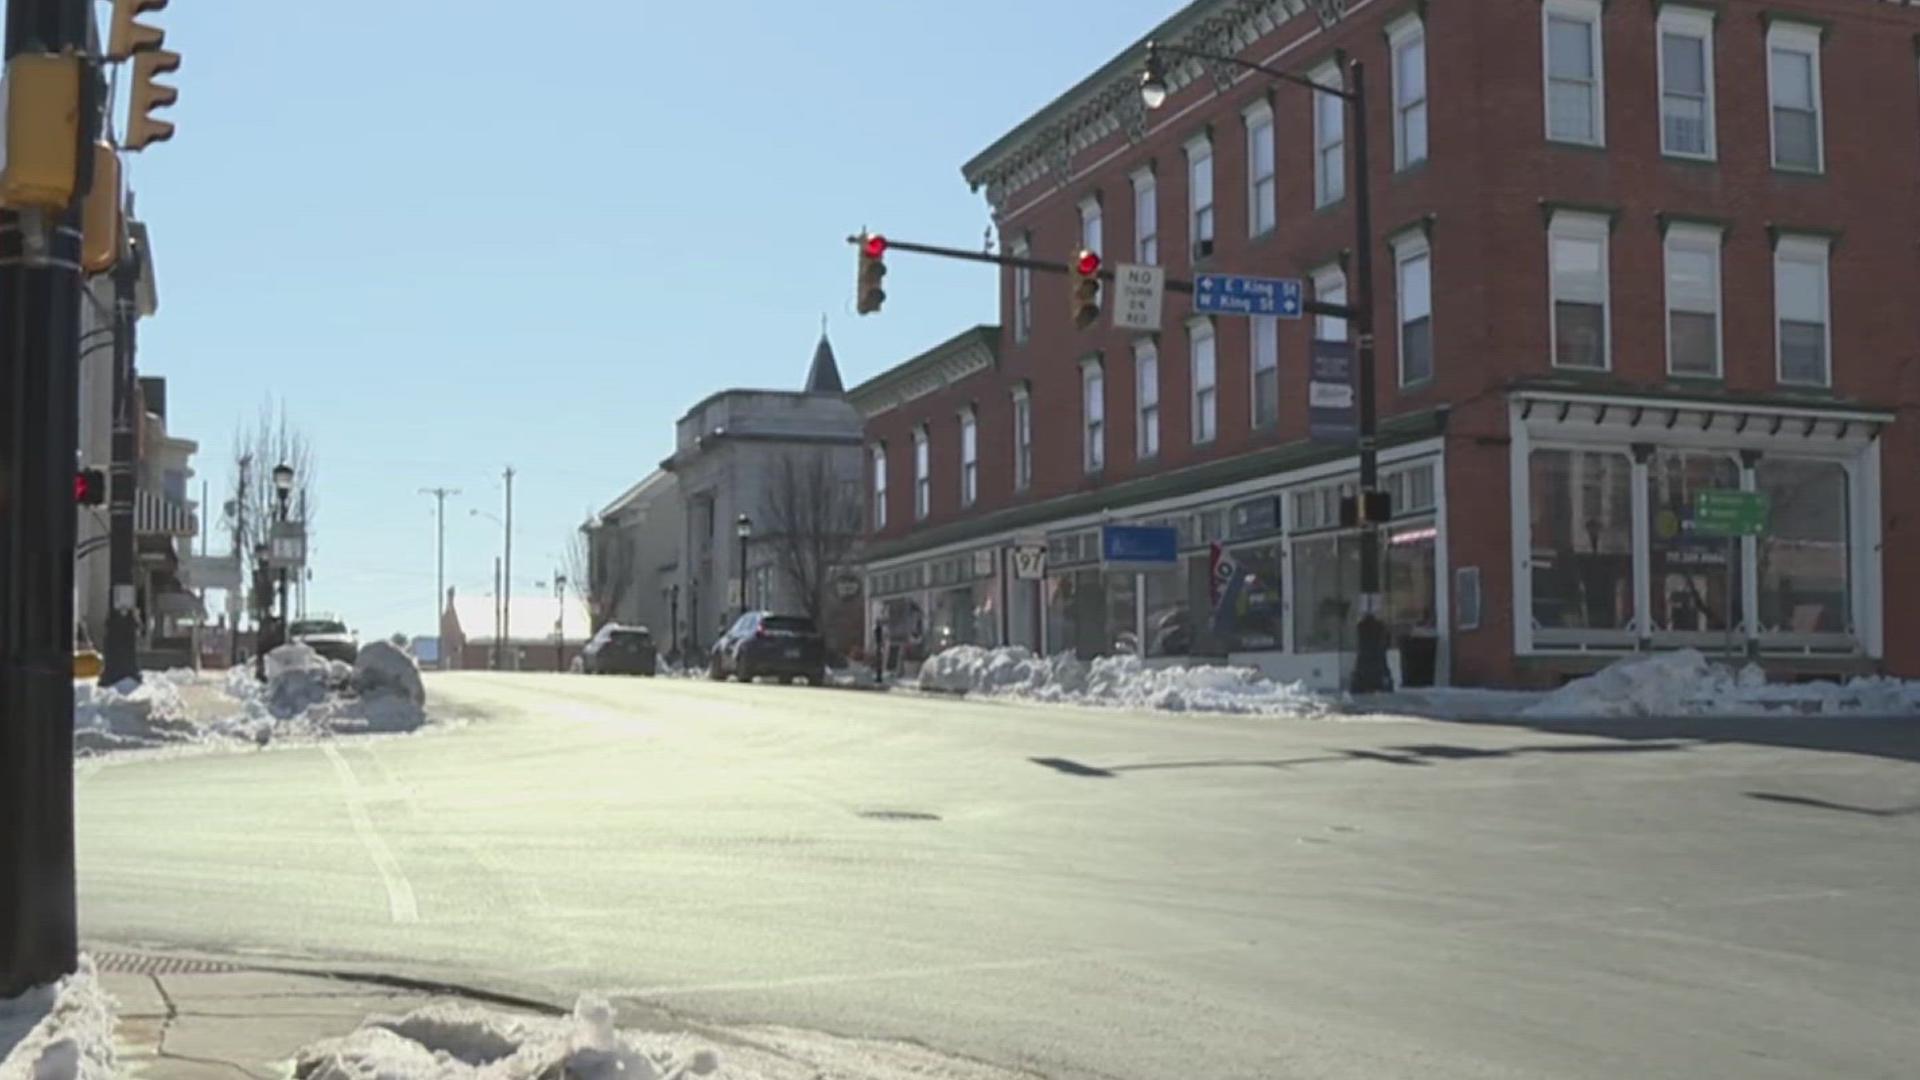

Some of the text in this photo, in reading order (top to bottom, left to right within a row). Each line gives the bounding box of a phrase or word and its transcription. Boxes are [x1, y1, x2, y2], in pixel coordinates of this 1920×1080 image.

[1129, 270, 1152, 284] NO
[1243, 280, 1273, 297] King
[1282, 282, 1296, 296] St
[1200, 294, 1274, 312] W King St
[1020, 552, 1040, 571] 97
